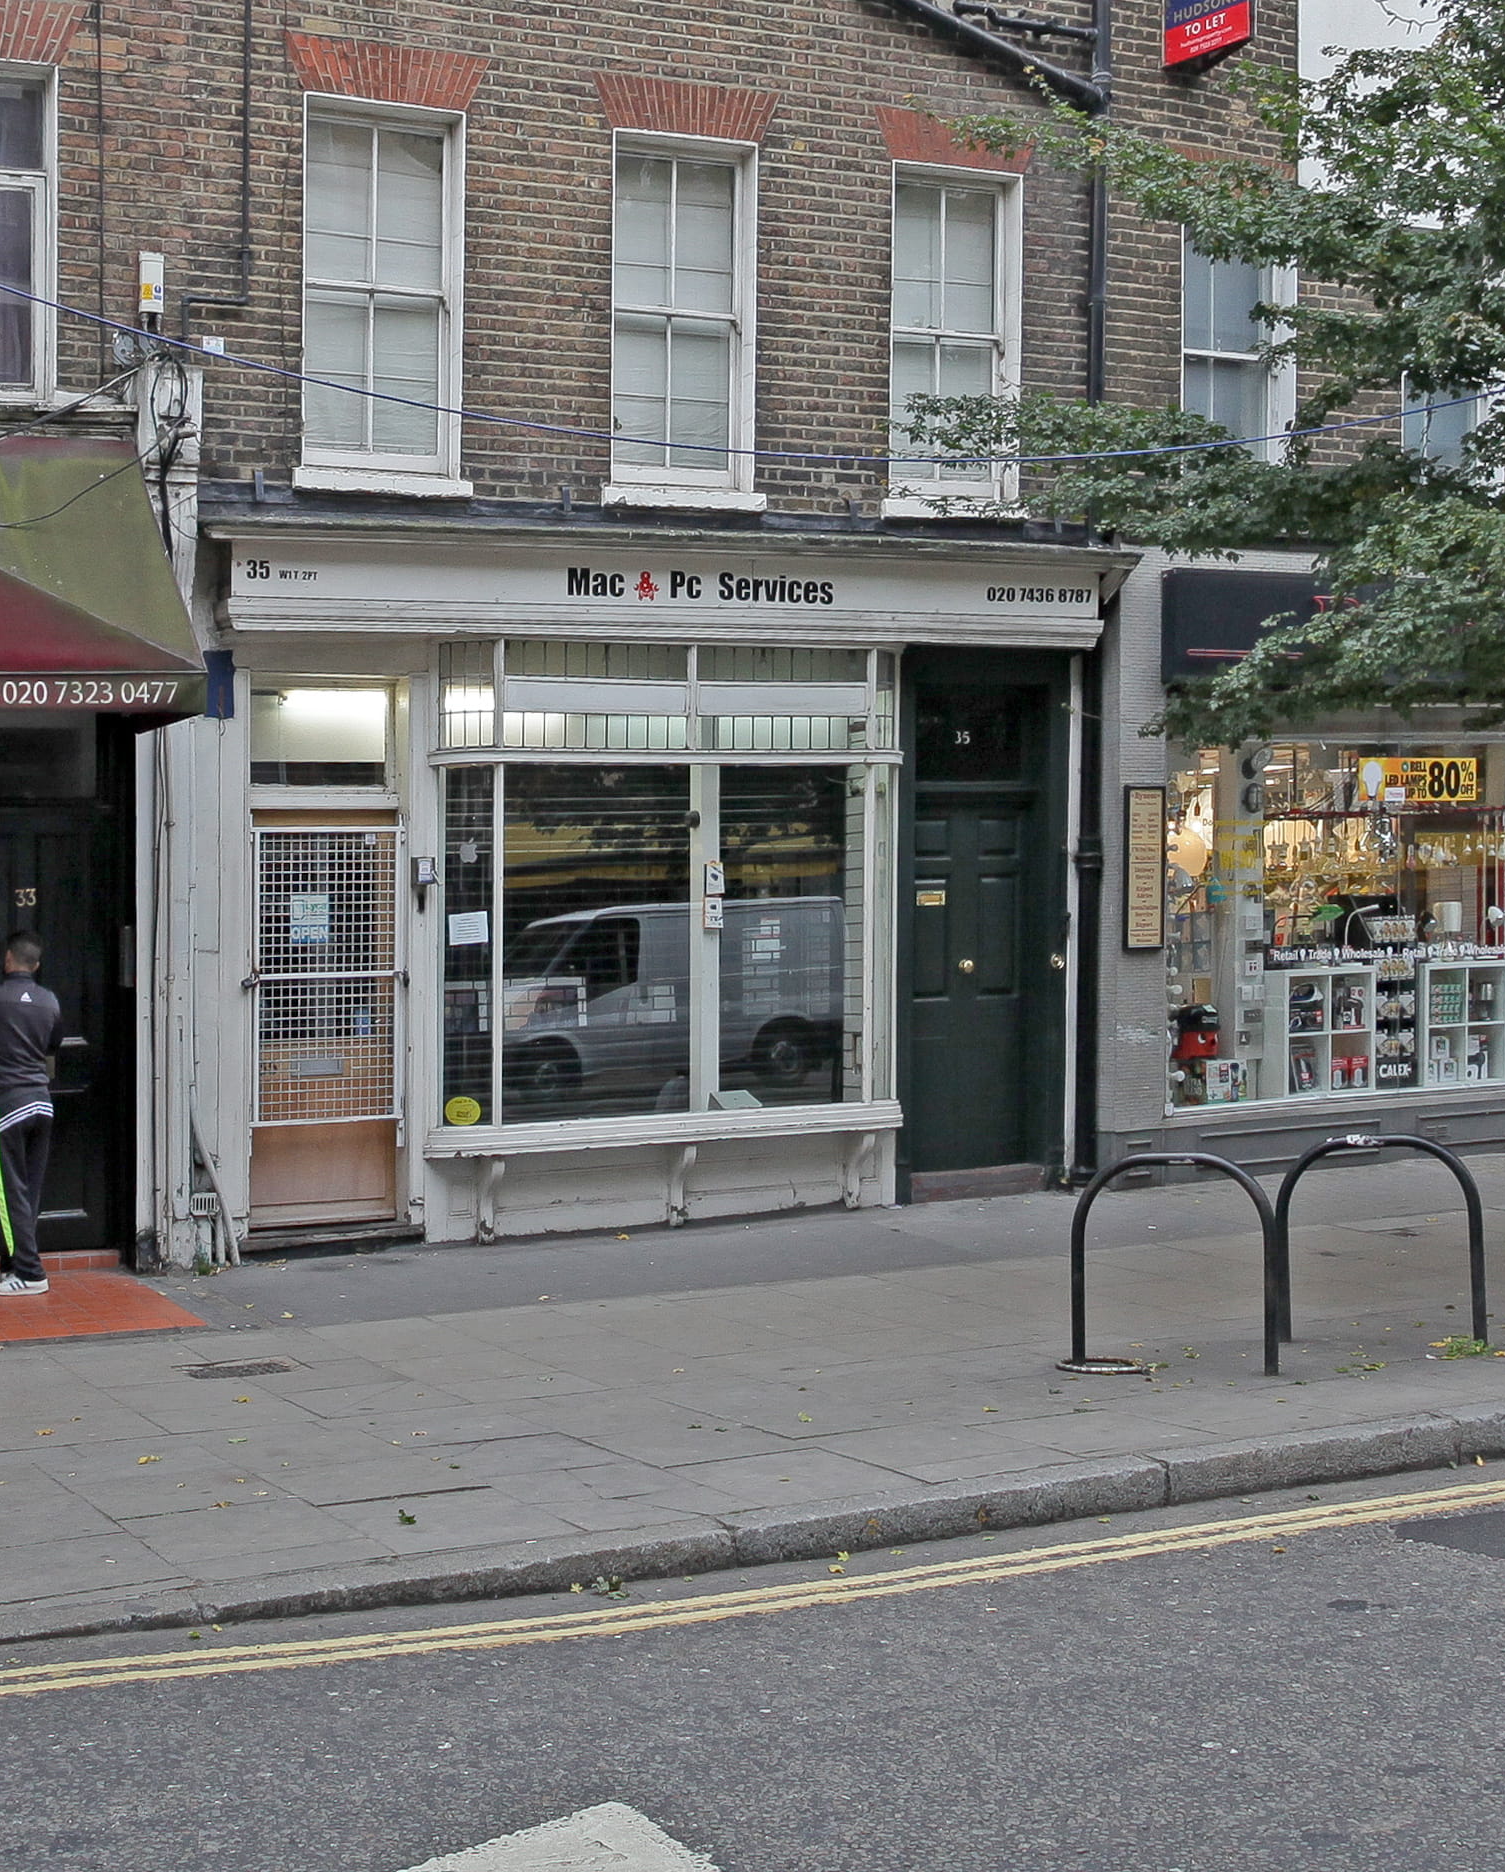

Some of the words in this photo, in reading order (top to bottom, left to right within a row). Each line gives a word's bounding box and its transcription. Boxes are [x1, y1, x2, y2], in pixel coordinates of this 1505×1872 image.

[1184, 22, 1201, 37] TO
[1205, 12, 1226, 31] LET
[246, 560, 270, 579] 35
[566, 567, 625, 598] Mac
[670, 570, 702, 600] Pc
[717, 572, 834, 605] Services
[986, 587, 1015, 602] 020
[1019, 588, 1055, 603] 7436
[1058, 588, 1092, 603] 8787
[2, 681, 48, 705] 020
[54, 681, 114, 705] 7323
[120, 681, 179, 705] 0477
[954, 731, 971, 745] 35
[1410, 761, 1428, 772] BELL
[1385, 774, 1399, 785] LED
[1400, 774, 1428, 787] LAMPS
[1405, 788, 1416, 799] UP
[1416, 788, 1428, 799] TO
[1460, 784, 1475, 795] OFF
[14, 888, 37, 907] 33
[291, 925, 328, 940] OPEN
[1273, 950, 1298, 961] Retail
[1308, 949, 1332, 961] Trade
[1342, 948, 1386, 960] Wholesale
[1402, 947, 1426, 959] Retail
